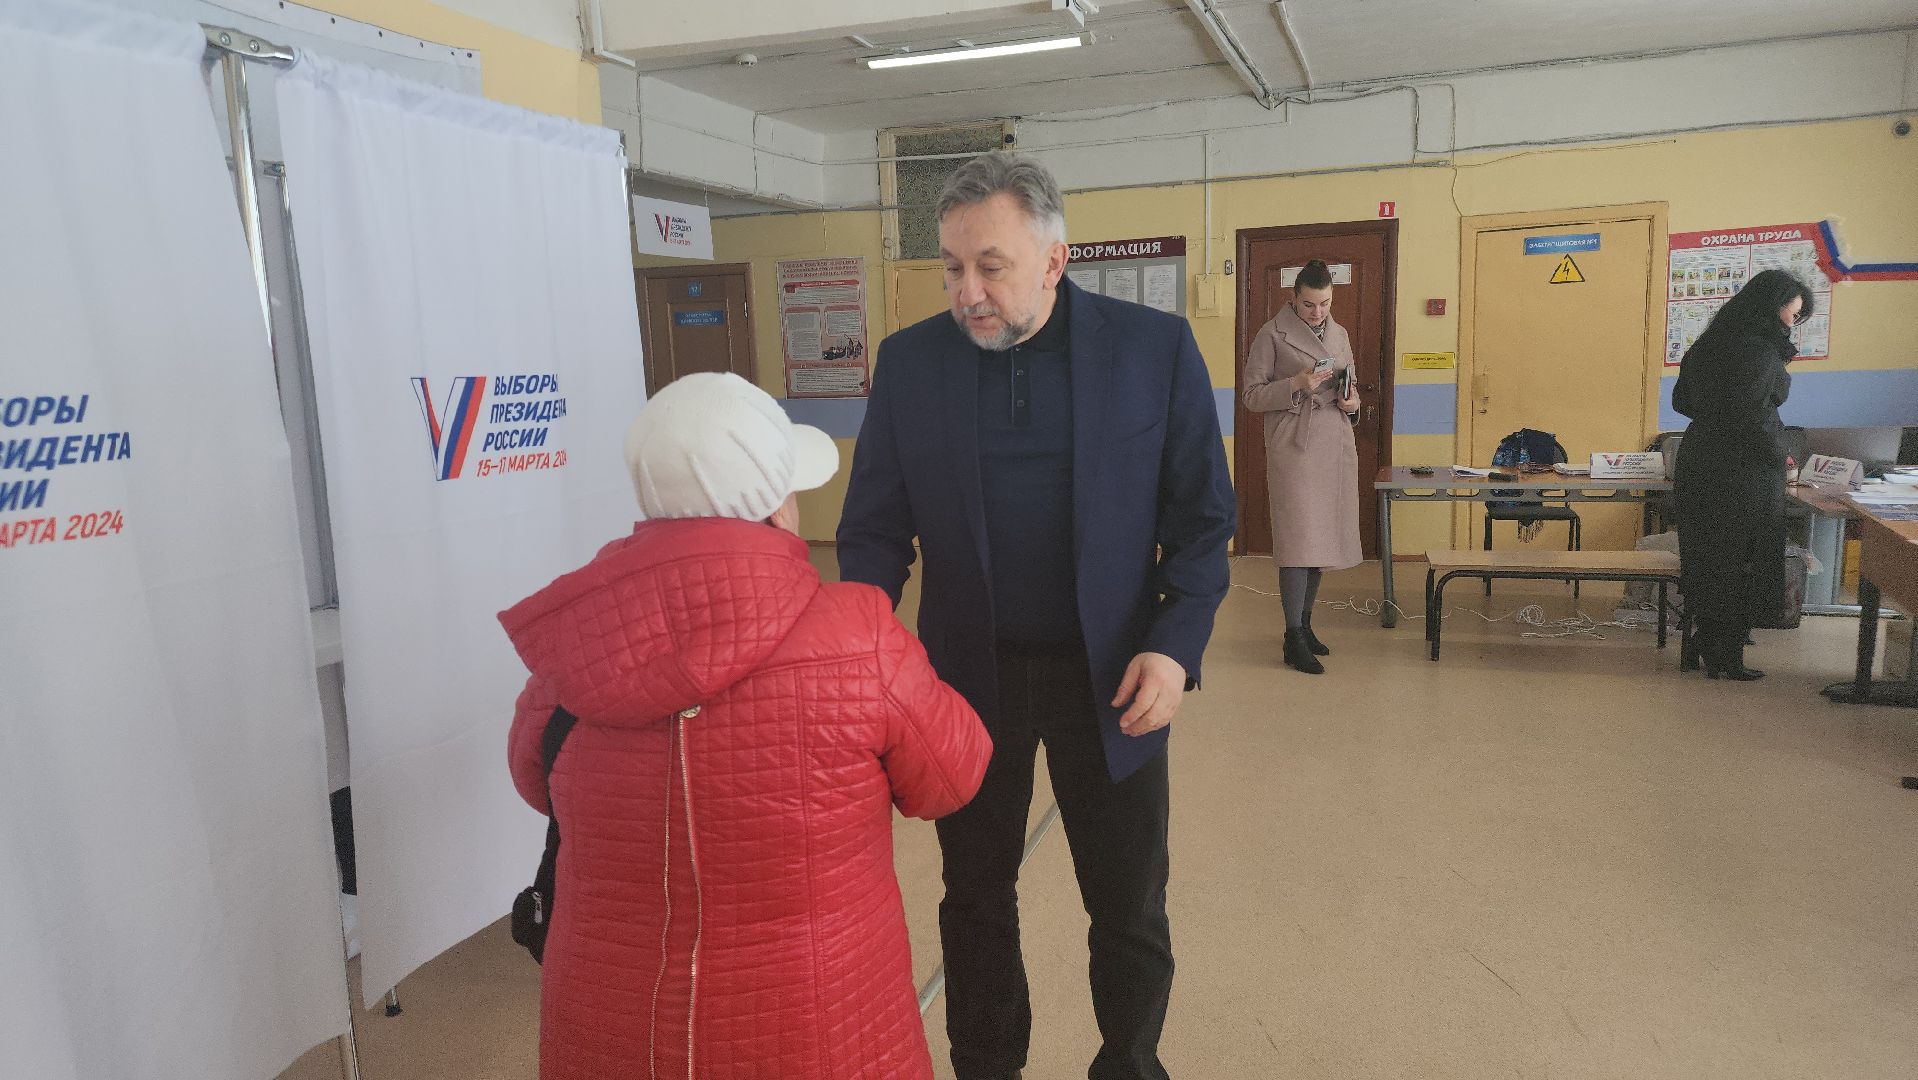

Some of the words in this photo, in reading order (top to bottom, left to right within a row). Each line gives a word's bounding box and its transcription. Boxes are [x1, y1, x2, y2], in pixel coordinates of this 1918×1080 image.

[1701, 232, 1755, 246] ОХРАНА
[1758, 229, 1802, 242] ТРУДА
[0, 394, 89, 427] ОРЫ
[482, 427, 548, 452] РОССИИ
[508, 451, 550, 472] МАРТА
[63, 510, 124, 541] 2024
